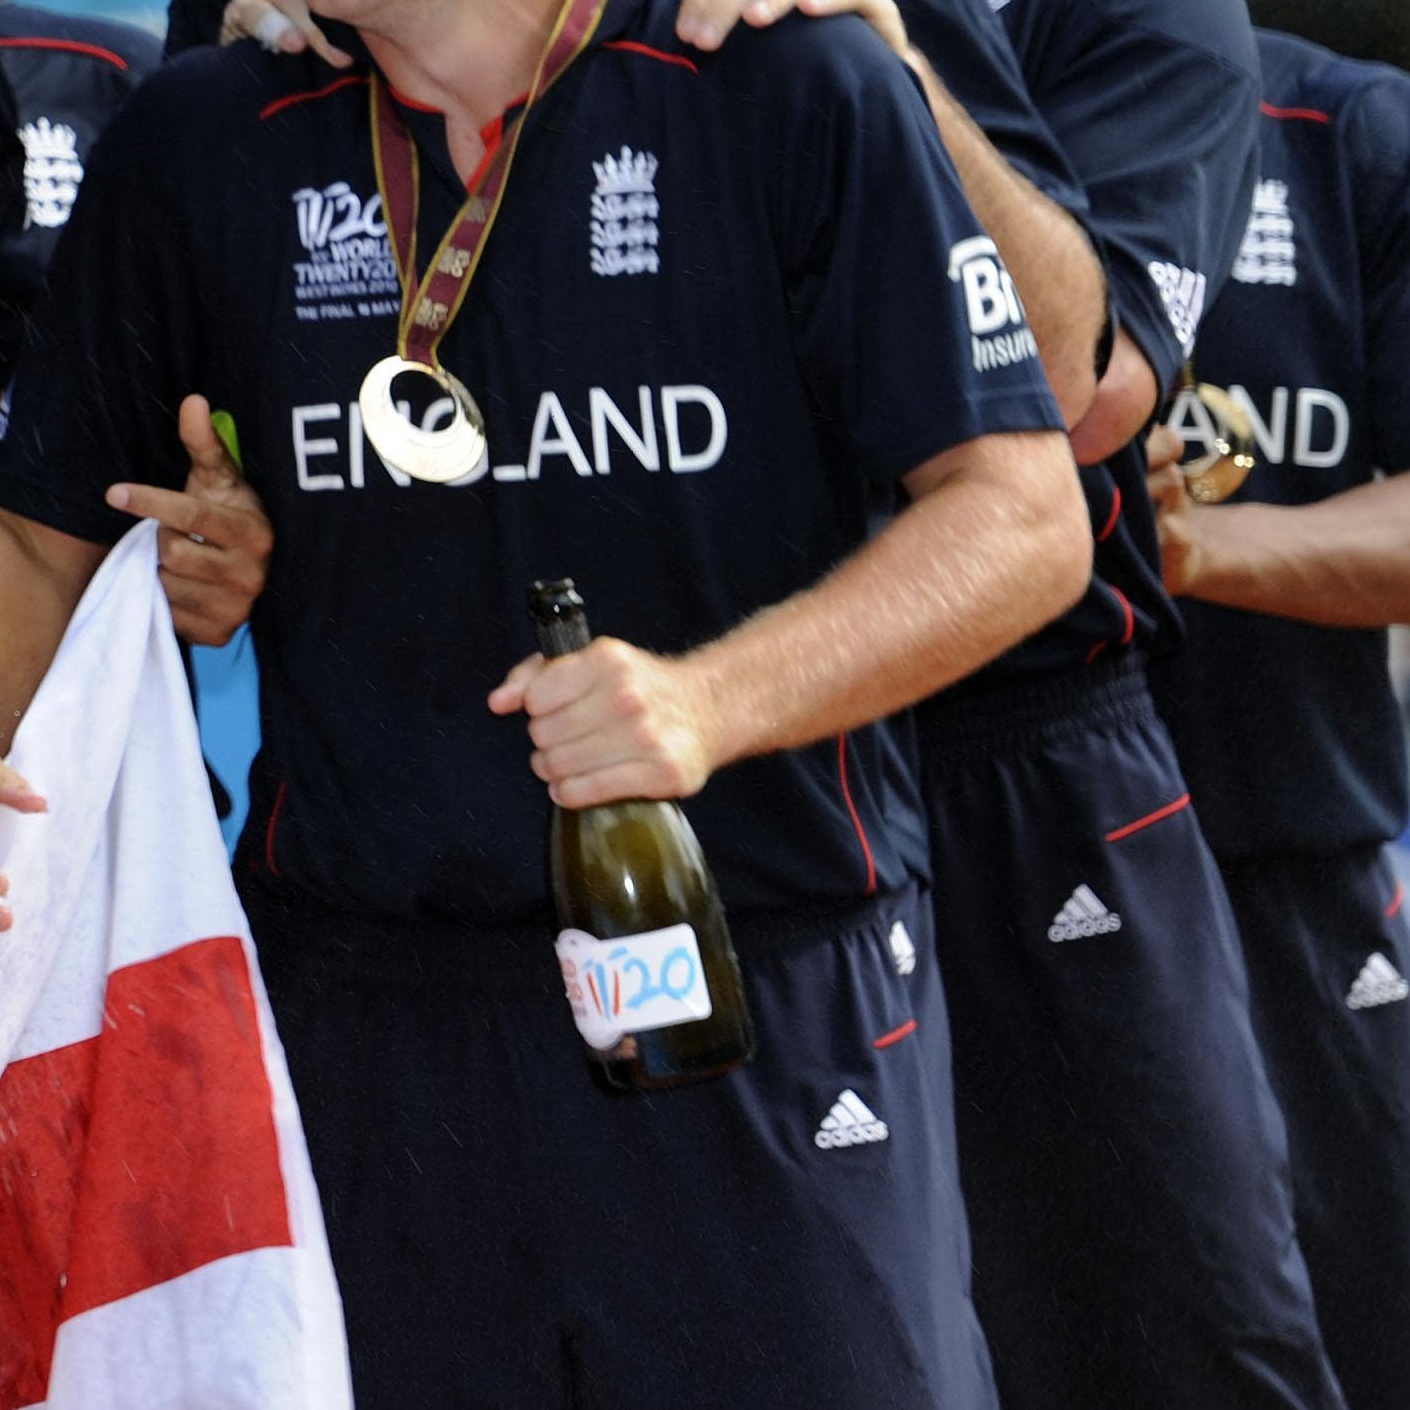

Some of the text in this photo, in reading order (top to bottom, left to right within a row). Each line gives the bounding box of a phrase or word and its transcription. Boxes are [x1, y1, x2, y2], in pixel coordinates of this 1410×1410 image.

[329, 237, 392, 263] WORL
[1047, 912, 1123, 943] adidas
[814, 1119, 890, 1149] adidas
